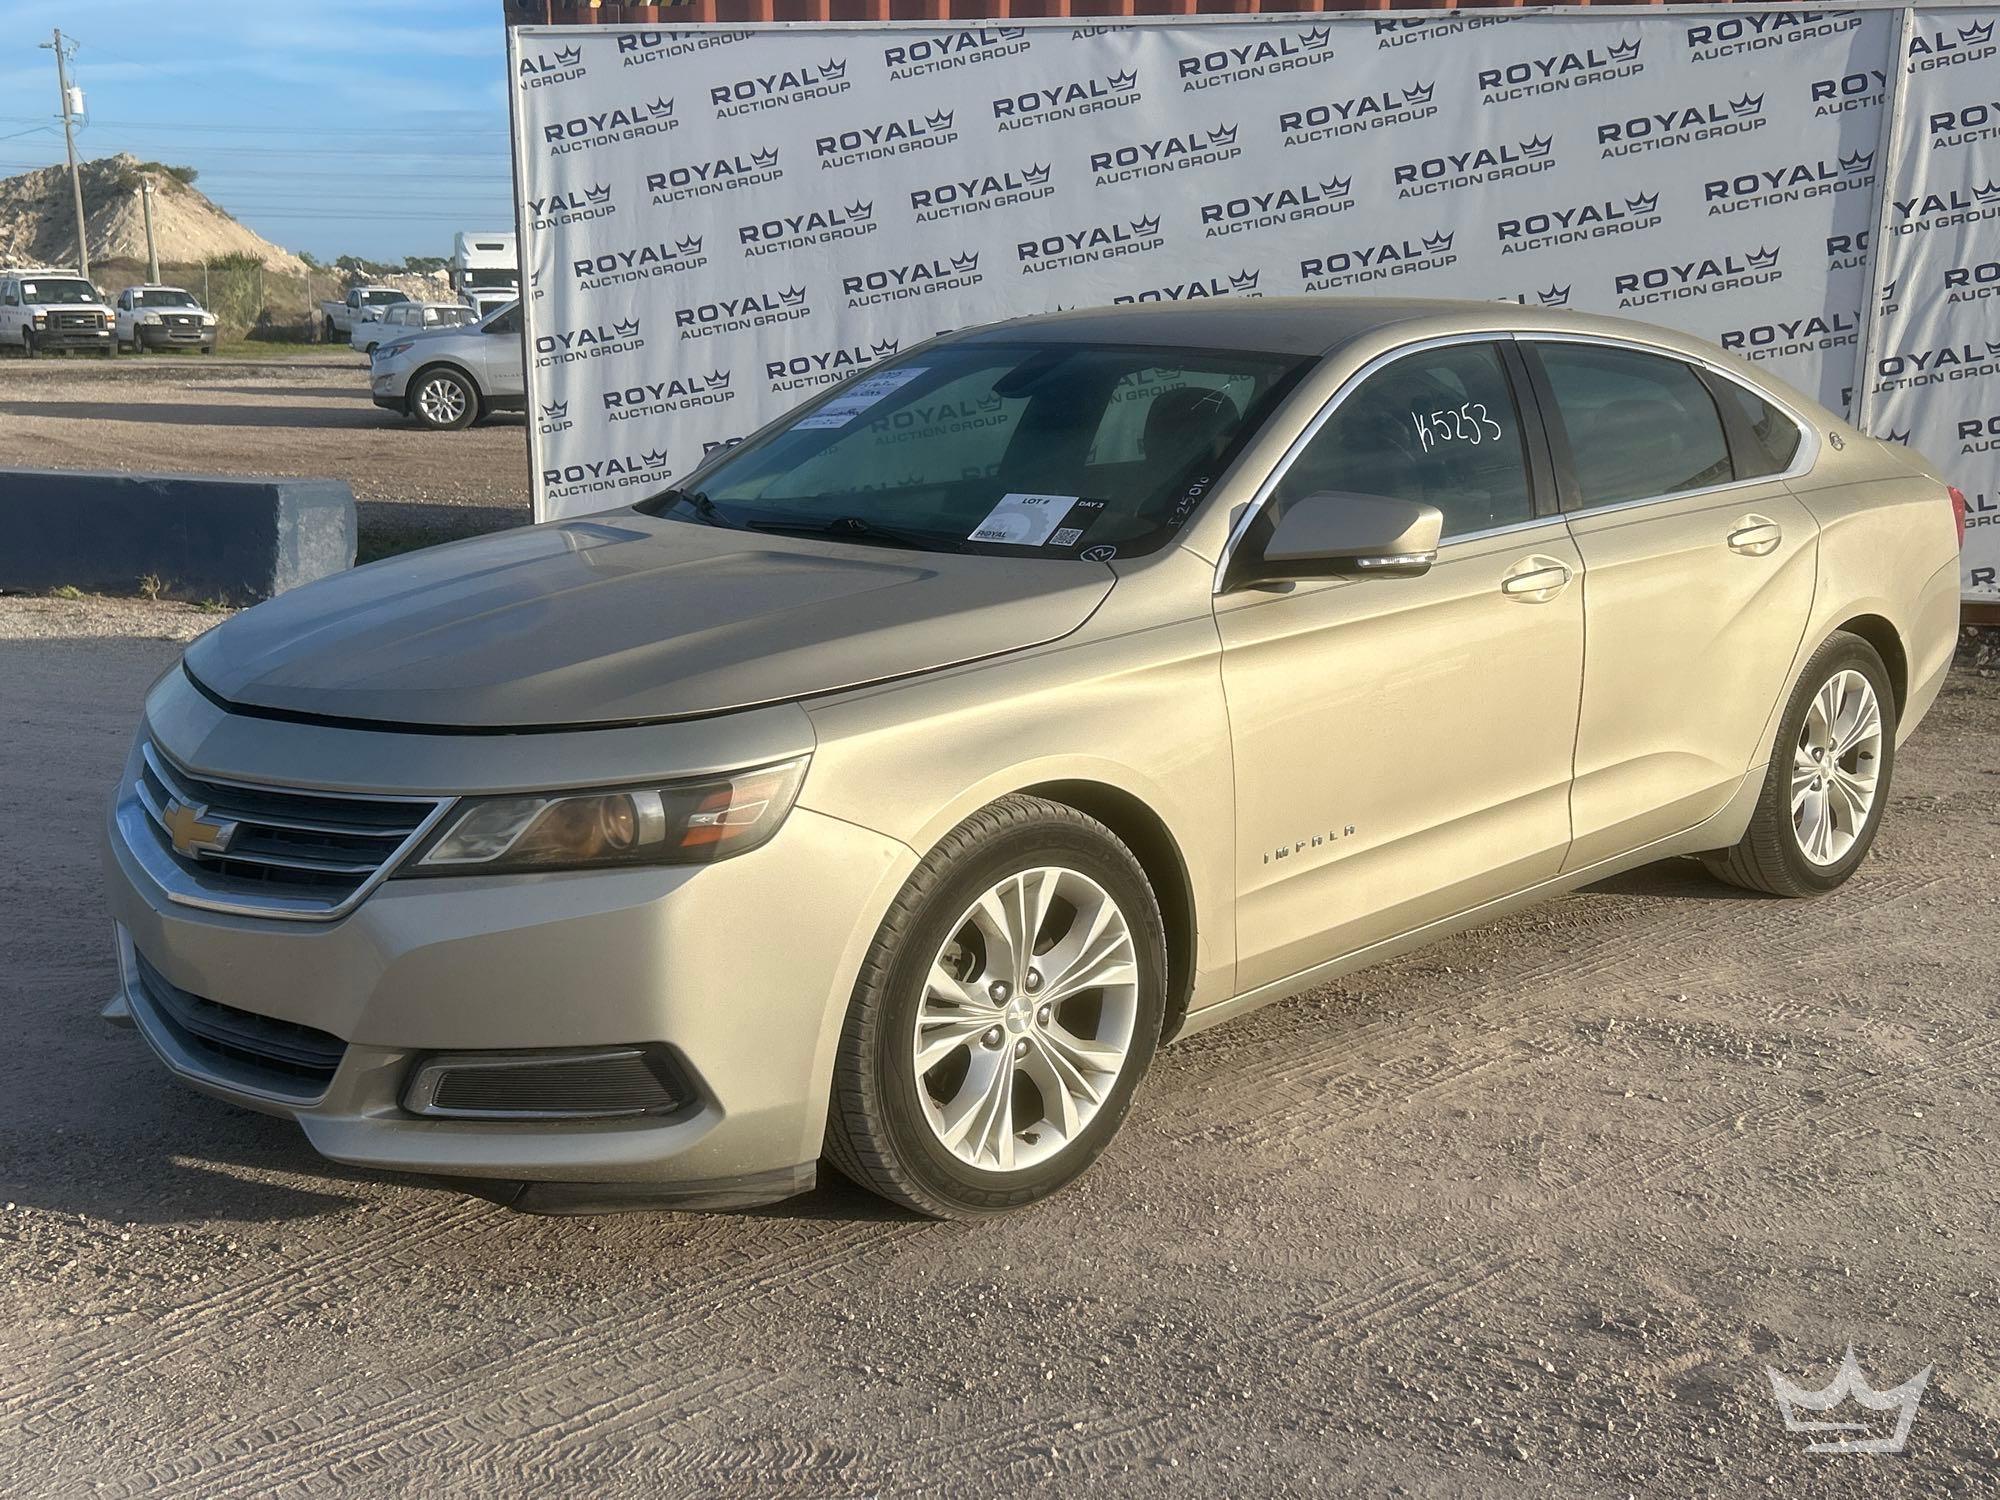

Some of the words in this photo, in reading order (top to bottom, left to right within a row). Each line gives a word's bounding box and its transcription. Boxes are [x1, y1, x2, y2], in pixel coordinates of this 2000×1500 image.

[623, 42, 694, 67] AUCTION
[884, 27, 998, 68] ROYAL
[1378, 22, 1464, 50] AUCTION
[1691, 34, 1782, 62] AUCTION
[1788, 17, 1862, 42] GROUP
[890, 56, 966, 81] AUCTION
[970, 41, 1031, 63] GROUP
[1179, 37, 1298, 77] ROYAL
[1183, 67, 1264, 92] AUCTION
[1269, 52, 1334, 74] GROUP
[1478, 48, 1607, 90] ROYAL
[1921, 47, 1997, 72] GROUP
[530, 68, 586, 88] GROUP
[710, 67, 819, 105] ROYAL
[1482, 78, 1569, 105] AUCTION
[1574, 64, 1644, 86] GROUP
[716, 96, 790, 119] AUCTION
[792, 81, 851, 102] GROUP
[993, 79, 1107, 118] ROYAL
[998, 108, 1075, 132] AUCTION
[1078, 93, 1141, 116] GROUP
[1280, 92, 1402, 133] ROYAL
[544, 107, 648, 142] ROYAL
[550, 134, 620, 156] AUCTION
[623, 119, 679, 140] GROUP
[816, 118, 926, 156] ROYAL
[1284, 120, 1367, 147] AUCTION
[1371, 106, 1438, 128] GROUP
[1598, 103, 1728, 144] ROYAL
[1601, 134, 1690, 159] AUCTION
[1695, 118, 1767, 140] GROUP
[821, 146, 895, 170] AUCTION
[898, 132, 958, 153] GROUP
[1091, 133, 1207, 172] ROYAL
[1095, 162, 1173, 186] AUCTION
[1176, 147, 1242, 170] GROUP
[1394, 145, 1520, 185] ROYAL
[646, 156, 752, 192] ROYAL
[652, 182, 723, 206] AUCTION
[726, 169, 784, 190] GROUP
[910, 172, 1022, 210] ROYAL
[1398, 175, 1483, 199] AUCTION
[1487, 160, 1556, 181] GROUP
[1705, 162, 1838, 201] ROYAL
[528, 192, 586, 216] YAL
[915, 200, 992, 223] AUCTION
[994, 186, 1055, 207] GROUP
[1201, 185, 1320, 224] ROYAL
[1708, 190, 1799, 216] AUCTION
[1804, 176, 1876, 198] GROUP
[1893, 190, 1971, 218] YAL
[560, 206, 616, 224] GROUP
[739, 209, 847, 244] ROYAL
[1205, 214, 1286, 238] AUCTION
[1290, 200, 1356, 222] GROUP
[1498, 202, 1625, 240] ROYAL
[1936, 206, 2000, 228] GROU
[744, 236, 817, 258] AUCTION
[820, 222, 877, 243] GROUP
[1017, 224, 1130, 261] ROYAL
[1501, 230, 1588, 255] AUCTION
[1592, 216, 1662, 239] GROUP
[573, 243, 677, 277] ROYAL
[579, 269, 649, 291] AUCTION
[652, 257, 707, 277] GROUP
[1022, 251, 1099, 275] AUCTION
[1102, 238, 1164, 259] GROUP
[1301, 240, 1421, 278] ROYAL
[1304, 269, 1386, 292] AUCTION
[1391, 255, 1457, 276] GROUP
[1615, 256, 1745, 294] ROYAL
[842, 260, 952, 295] ROYAL
[847, 286, 922, 308] AUCTION
[924, 273, 984, 294] GROUP
[1619, 284, 1706, 309] AUCTION
[1712, 271, 1782, 292] GROUP
[675, 293, 781, 327] ROYAL
[680, 319, 751, 341] AUCTION
[754, 307, 810, 327] GROUP
[536, 326, 614, 354] OYAL
[590, 340, 644, 358] GROUP
[1721, 313, 1853, 350] ROYAL
[766, 346, 872, 380] ROYAL
[1878, 344, 1985, 377] OYAL
[603, 378, 705, 409] ROYAL
[771, 369, 843, 392] AUCTION
[608, 400, 677, 423] AUCTION
[679, 391, 735, 410] GROUP
[950, 414, 1008, 432] GROUP
[543, 457, 643, 486] ROYAL
[548, 479, 616, 499] AUCTION
[618, 470, 672, 488] GROUP
[1089, 549, 1112, 561] 12
[1264, 824, 1355, 864] IMPALA
